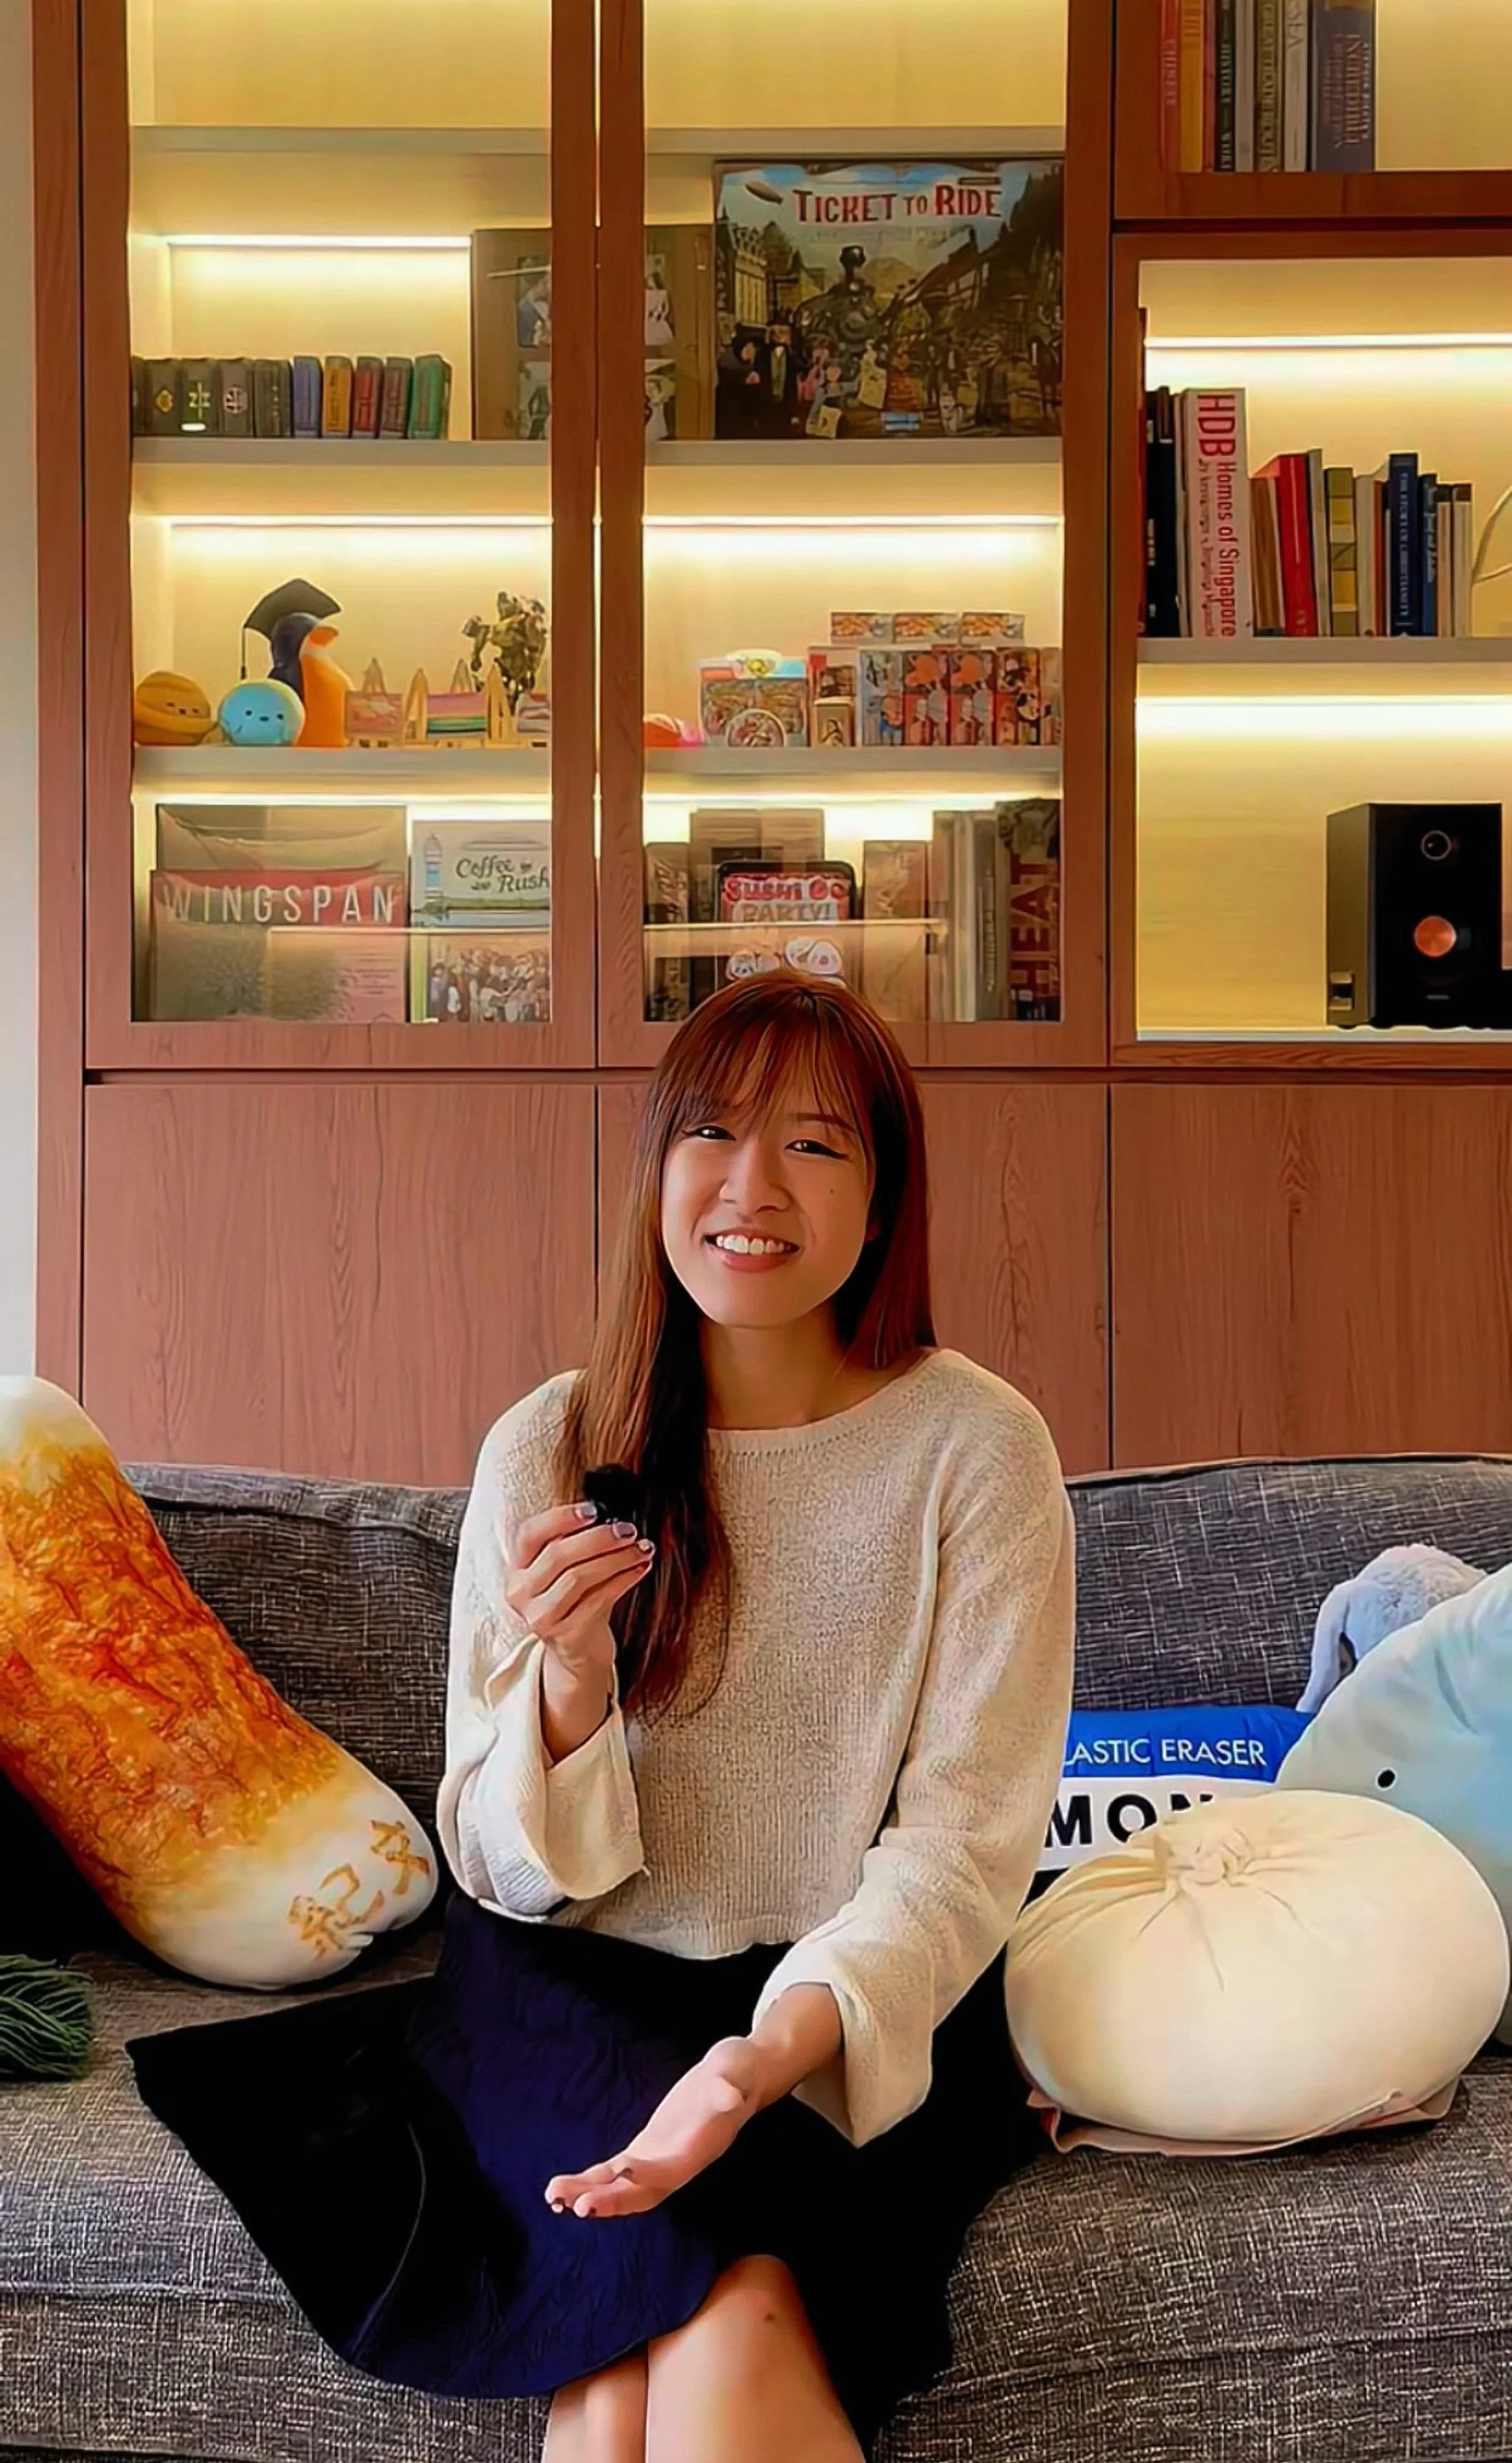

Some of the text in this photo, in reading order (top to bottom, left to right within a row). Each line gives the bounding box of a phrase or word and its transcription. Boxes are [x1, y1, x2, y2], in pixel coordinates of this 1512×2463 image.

[792, 184, 1002, 223] TICKET TO RIDE
[1197, 393, 1237, 457] HDB
[1216, 460, 1237, 521] Homes
[1218, 526, 1239, 543] of
[1214, 548, 1241, 636] Singapore
[454, 854, 516, 880] Coffee
[498, 866, 550, 894] Rush
[162, 883, 394, 925] WINGSPAN
[1010, 852, 1059, 996] HEAT
[1162, 1738, 1268, 1766] ERASER
